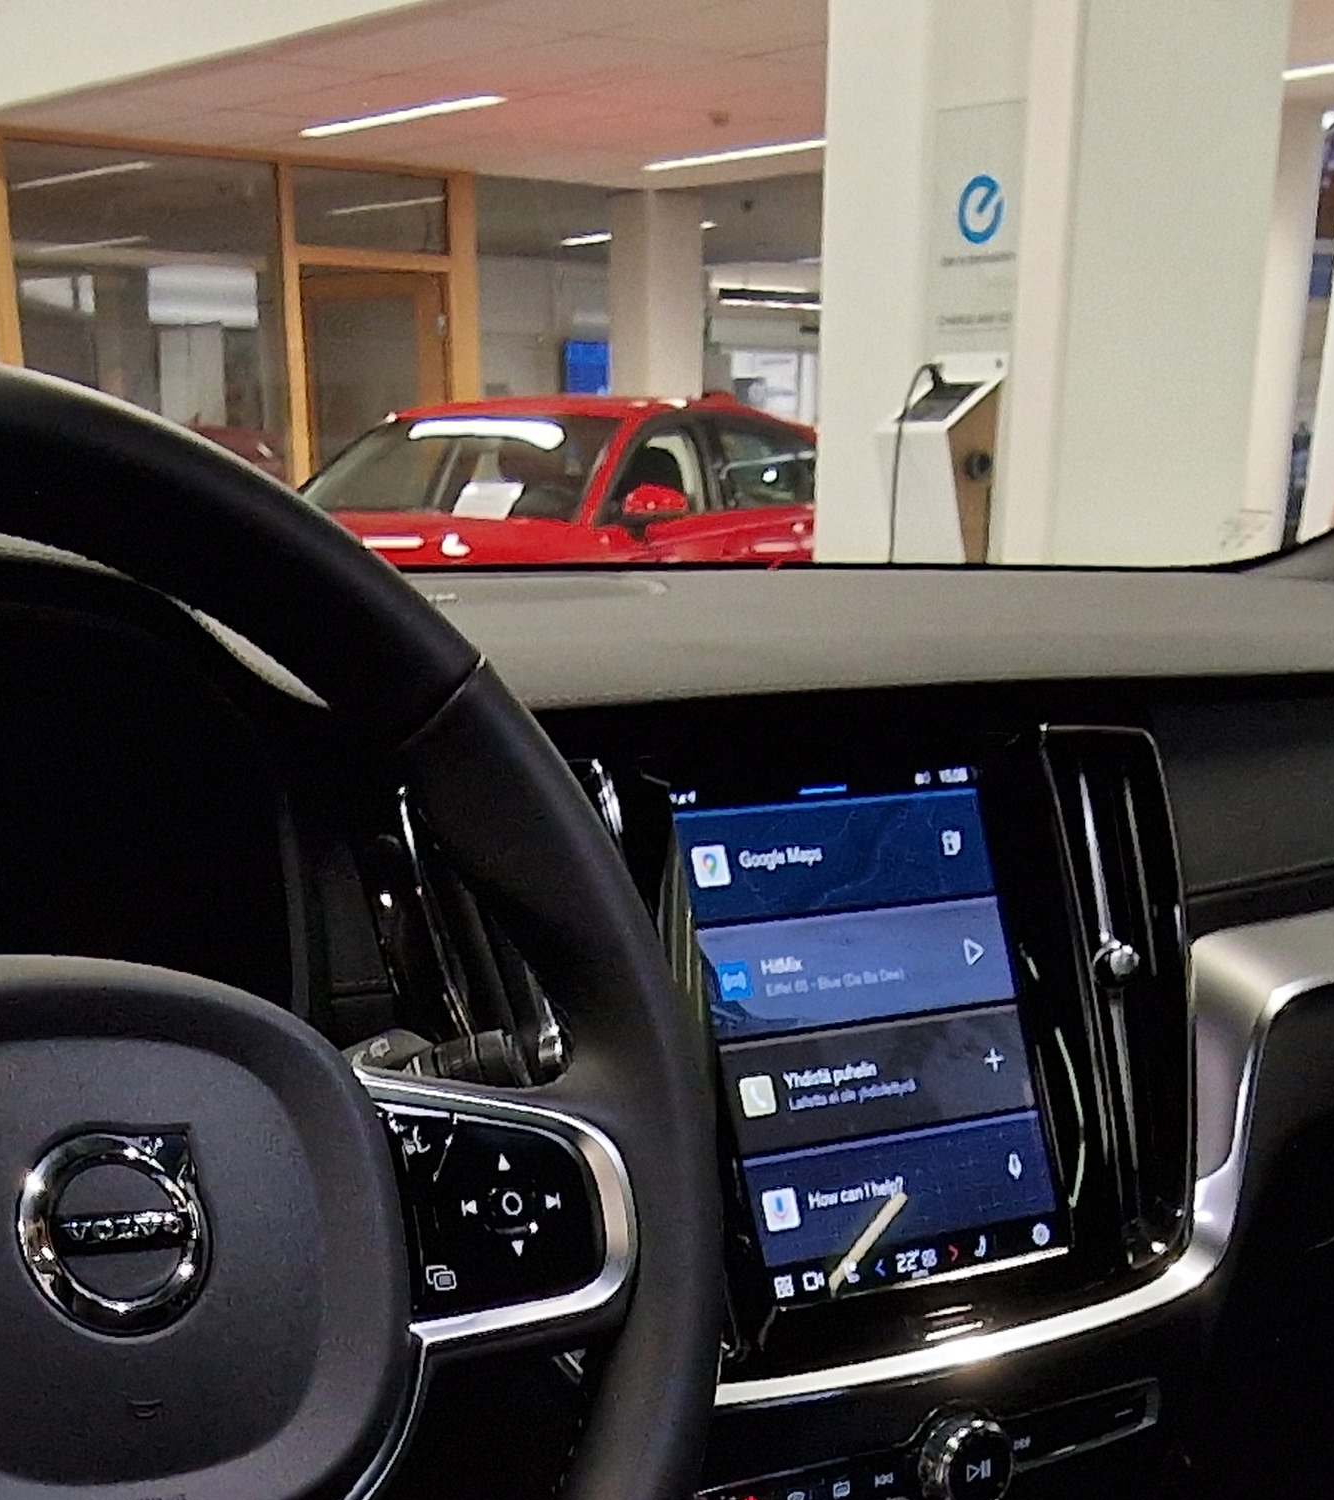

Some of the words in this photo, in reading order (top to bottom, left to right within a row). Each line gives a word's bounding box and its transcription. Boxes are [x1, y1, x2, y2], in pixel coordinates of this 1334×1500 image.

[738, 848, 785, 870] Google
[786, 845, 823, 867] Maps
[817, 975, 842, 990] Blue
[808, 1191, 838, 1209] How
[840, 1187, 864, 1204] can
[871, 1175, 904, 1199] help?
[61, 1211, 184, 1241] VOLVO
